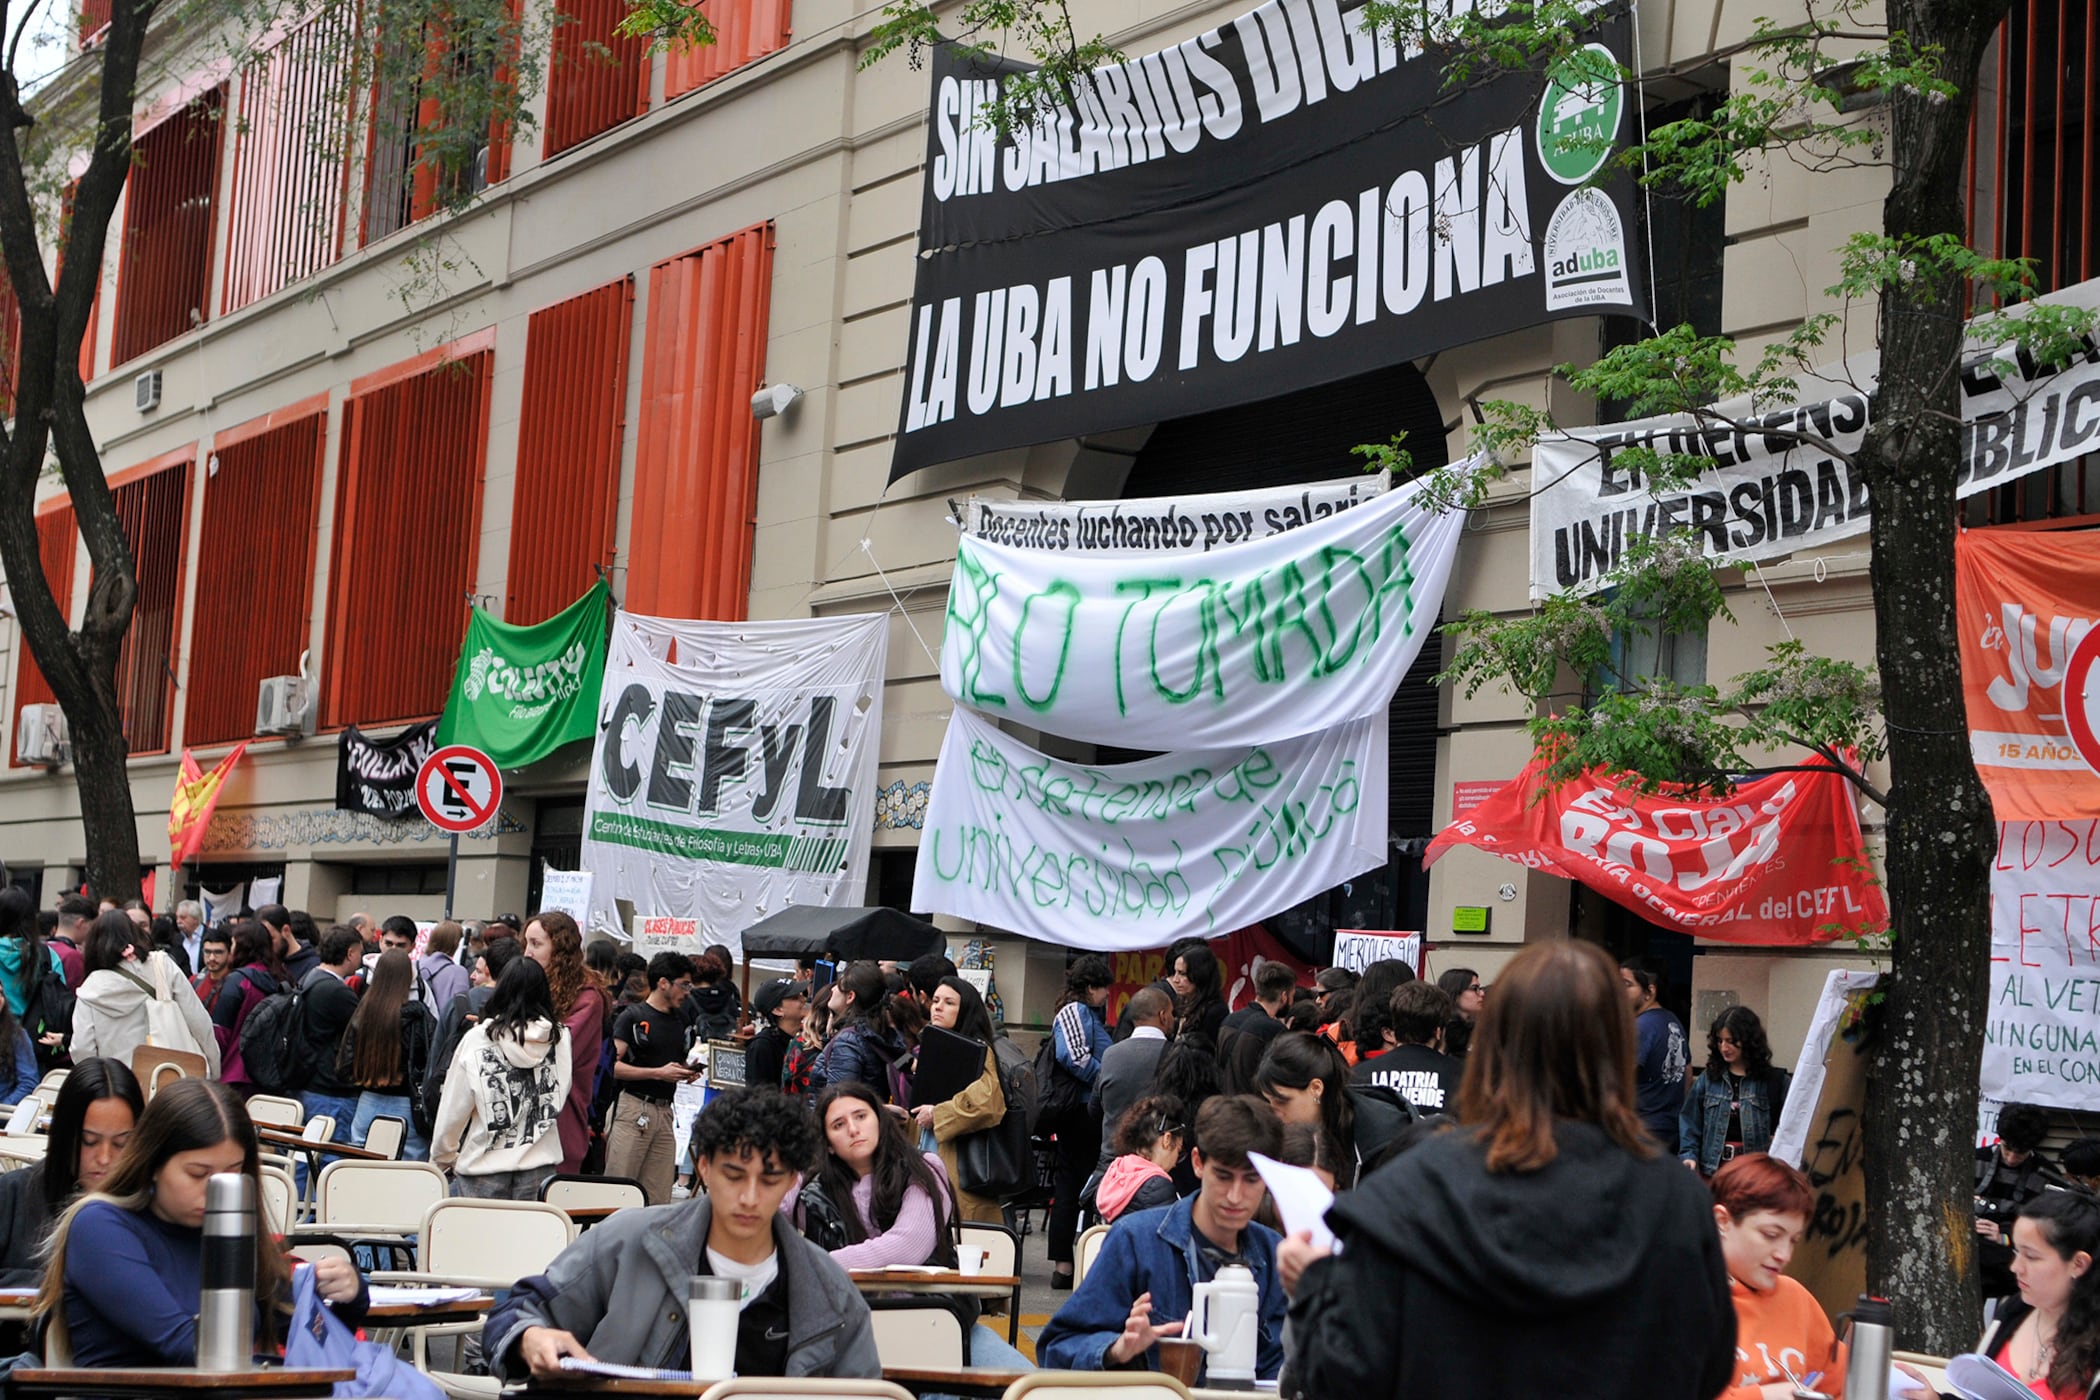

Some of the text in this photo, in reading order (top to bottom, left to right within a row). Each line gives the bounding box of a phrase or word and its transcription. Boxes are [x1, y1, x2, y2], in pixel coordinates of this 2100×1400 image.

[933, 75, 999, 202] SIN
[906, 126, 1535, 434] LA UBA NO FUNCIONA
[1552, 246, 1619, 277] aduba
[977, 504, 1070, 551] Docentes
[1076, 504, 1197, 551] luchando
[1201, 509, 1252, 552] por
[1116, 523, 1415, 717] TOMADA
[602, 683, 852, 827] CEFyL
[1999, 743, 2021, 759] 15
[594, 816, 623, 836] Centro
[674, 830, 685, 848] de
[1560, 813, 1782, 891] ROJA
[1759, 896, 1792, 919] del
[1796, 885, 1863, 919] CEFL
[2000, 974, 2100, 1015] AL VET
[1984, 1020, 2100, 1054] NINGUNA
[1371, 1070, 1439, 1089] LA PATRIA
[2013, 1057, 2032, 1075] EN
[2038, 1059, 2056, 1076] EL
